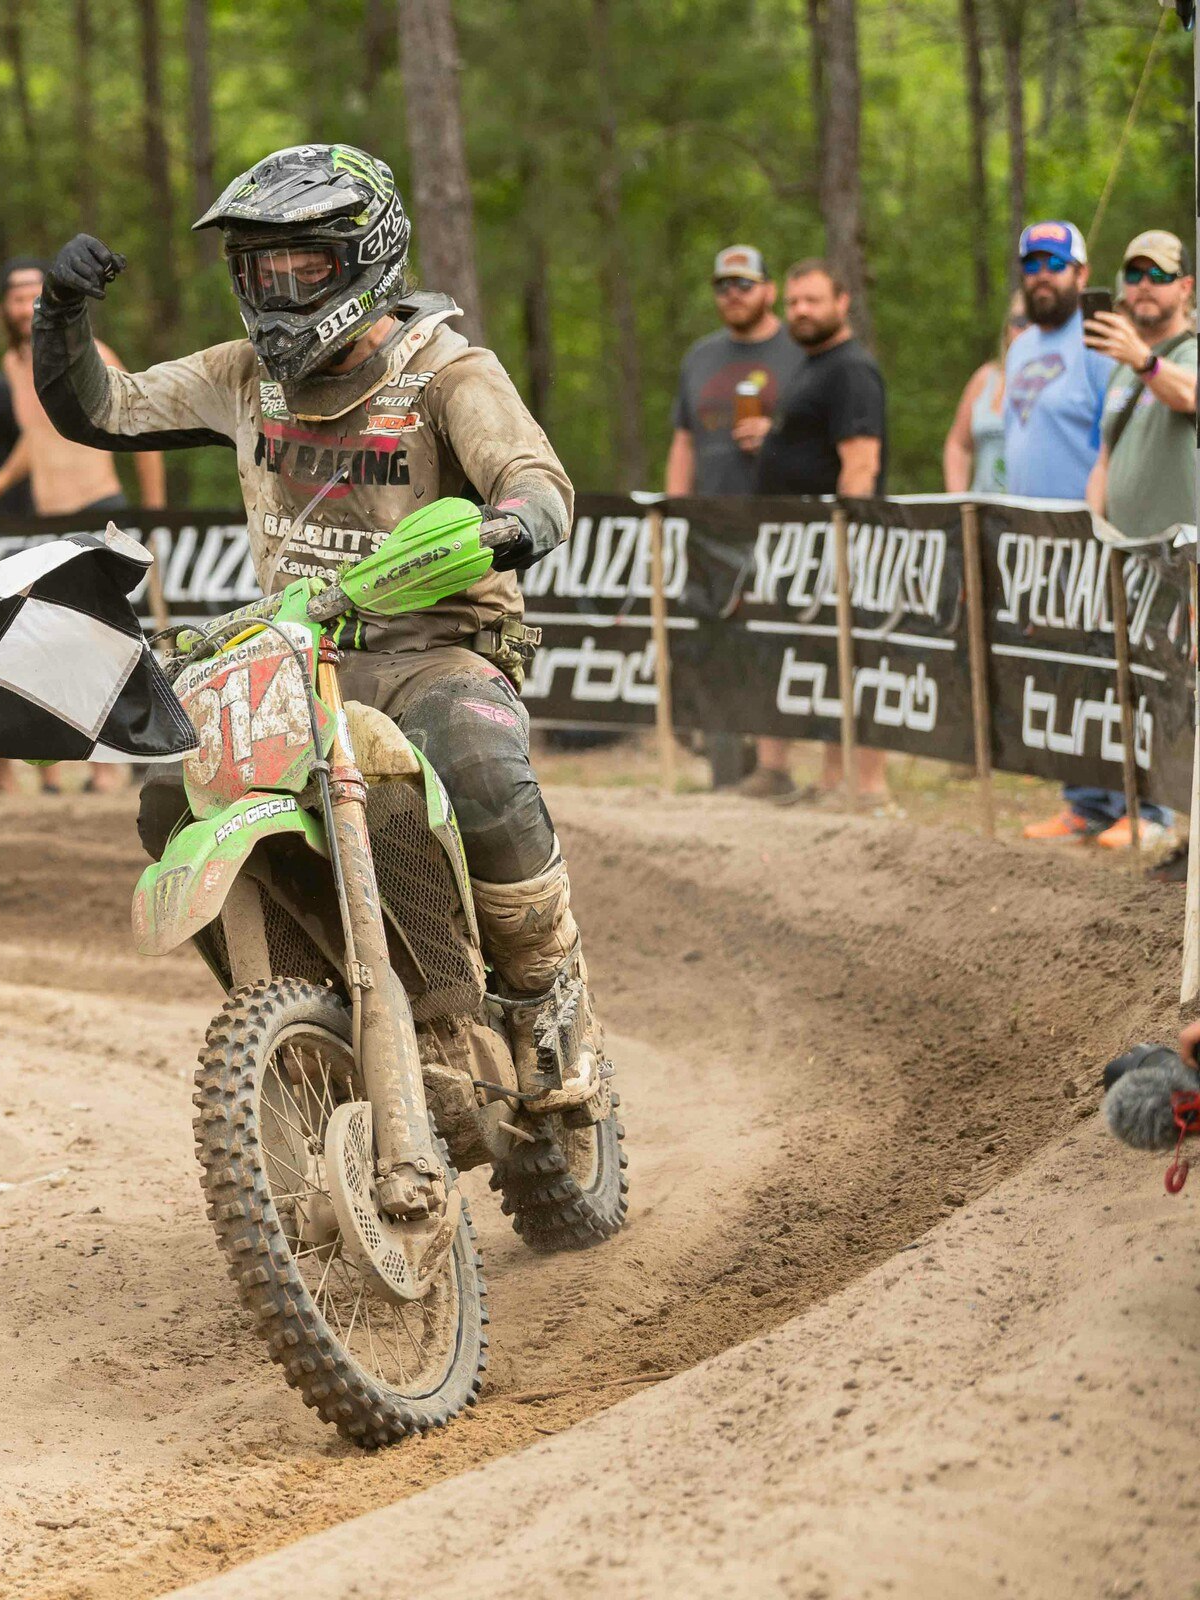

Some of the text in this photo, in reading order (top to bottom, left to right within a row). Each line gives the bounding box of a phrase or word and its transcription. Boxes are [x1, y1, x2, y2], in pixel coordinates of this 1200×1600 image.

[318, 300, 361, 341] 314
[276, 556, 341, 584] Kawas
[215, 813, 244, 846] PRO
